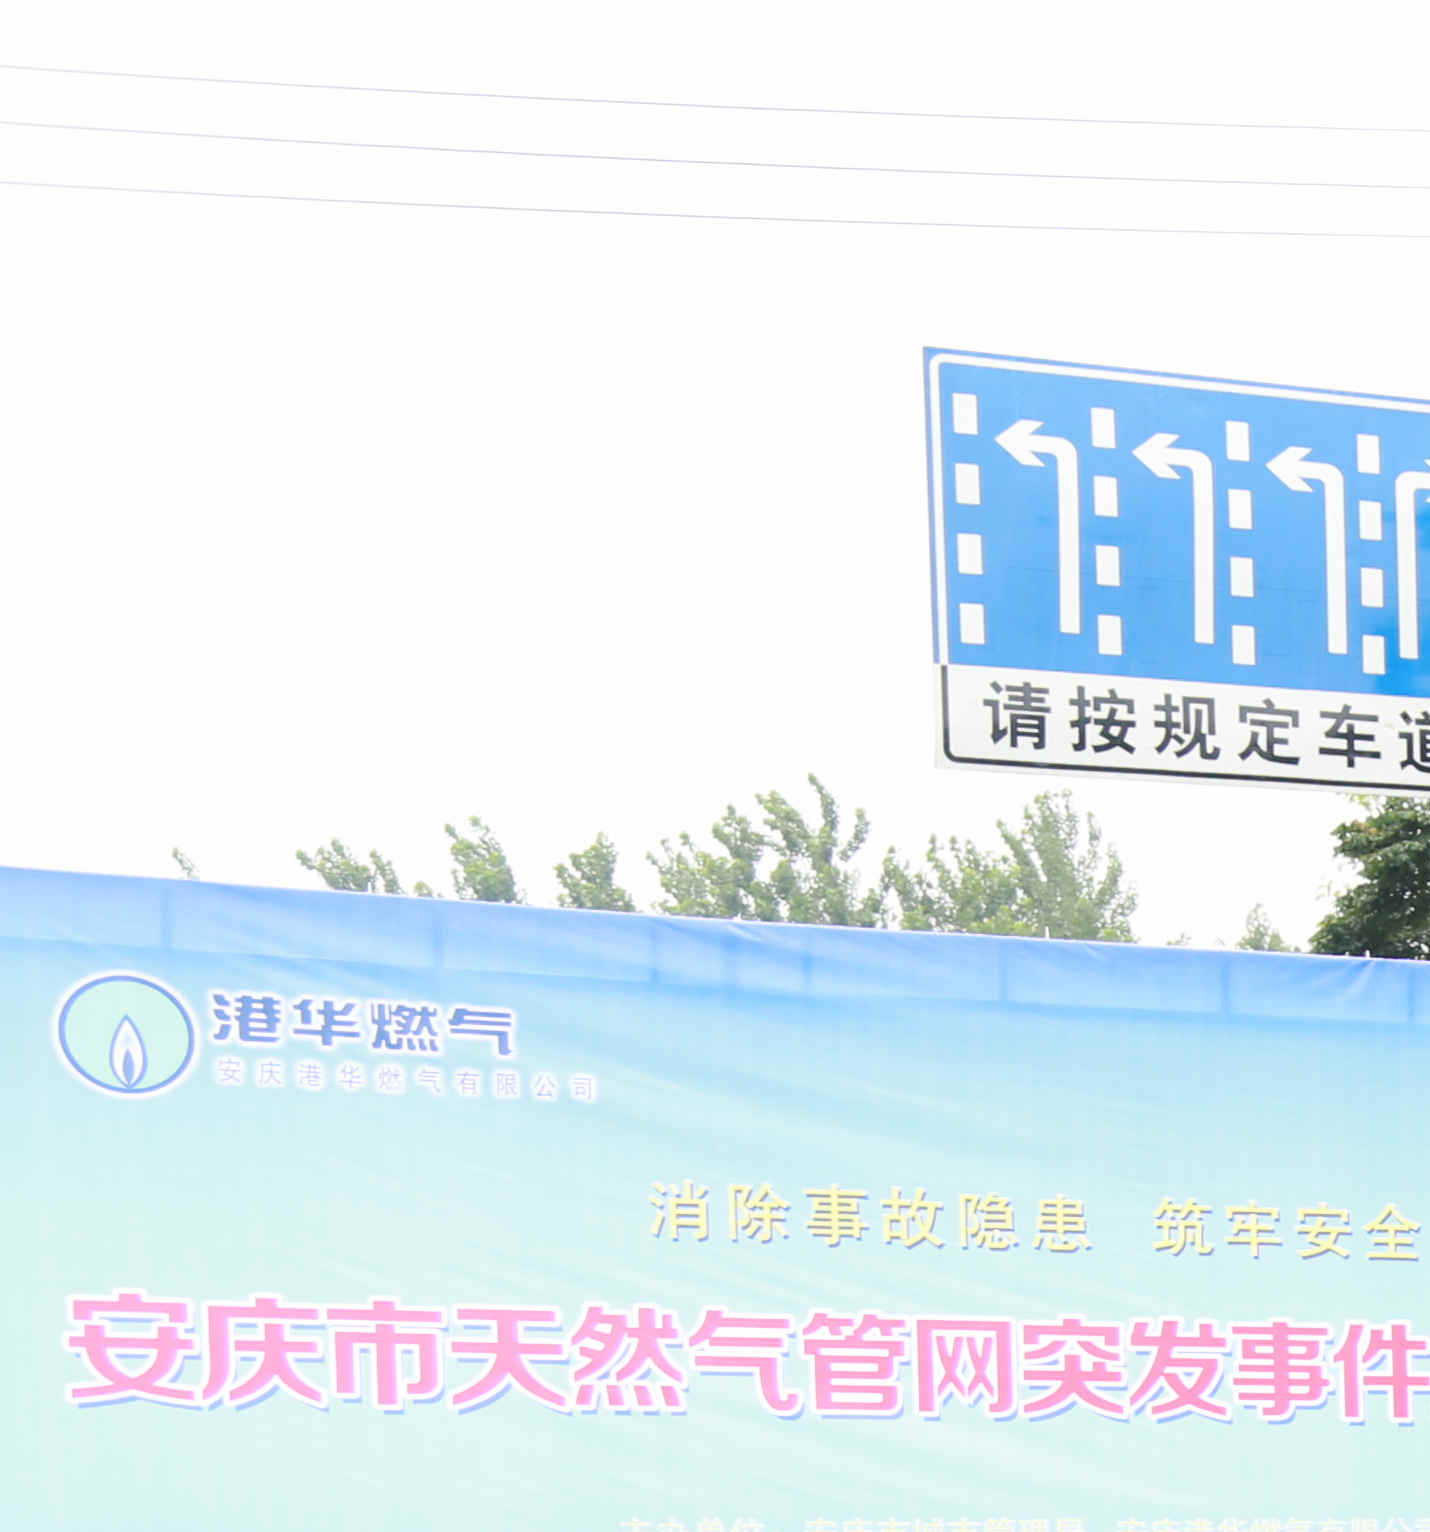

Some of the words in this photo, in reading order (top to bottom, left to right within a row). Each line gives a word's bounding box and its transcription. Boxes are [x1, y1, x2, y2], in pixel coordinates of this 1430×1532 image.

[212, 993, 513, 1057] 港华燃气
[215, 1058, 597, 1103] 安庆港华燃气有限公司
[646, 1177, 1095, 1256] 消除事故隐患
